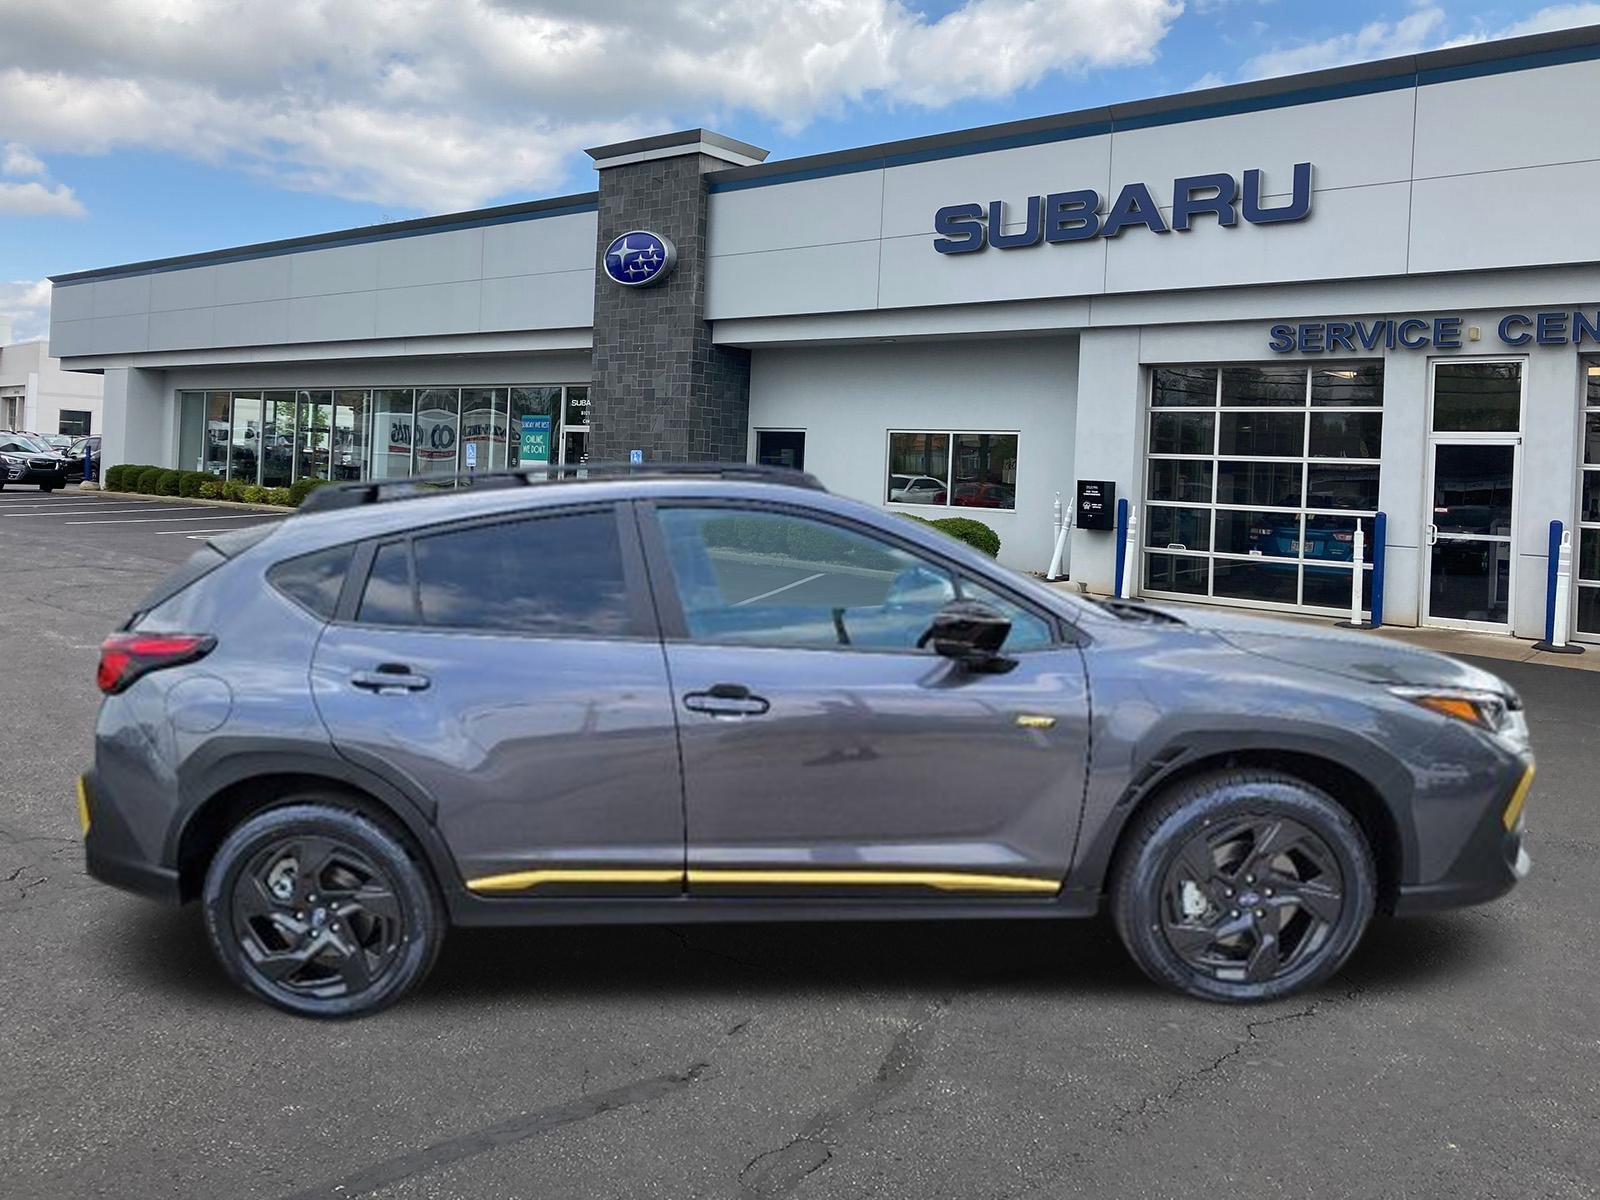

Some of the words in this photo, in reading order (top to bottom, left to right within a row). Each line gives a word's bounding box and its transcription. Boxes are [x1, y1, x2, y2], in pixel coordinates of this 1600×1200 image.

[933, 161, 1313, 255] SUBARU
[1269, 317, 1463, 353] SERVICE
[1497, 310, 1600, 346] CEN
